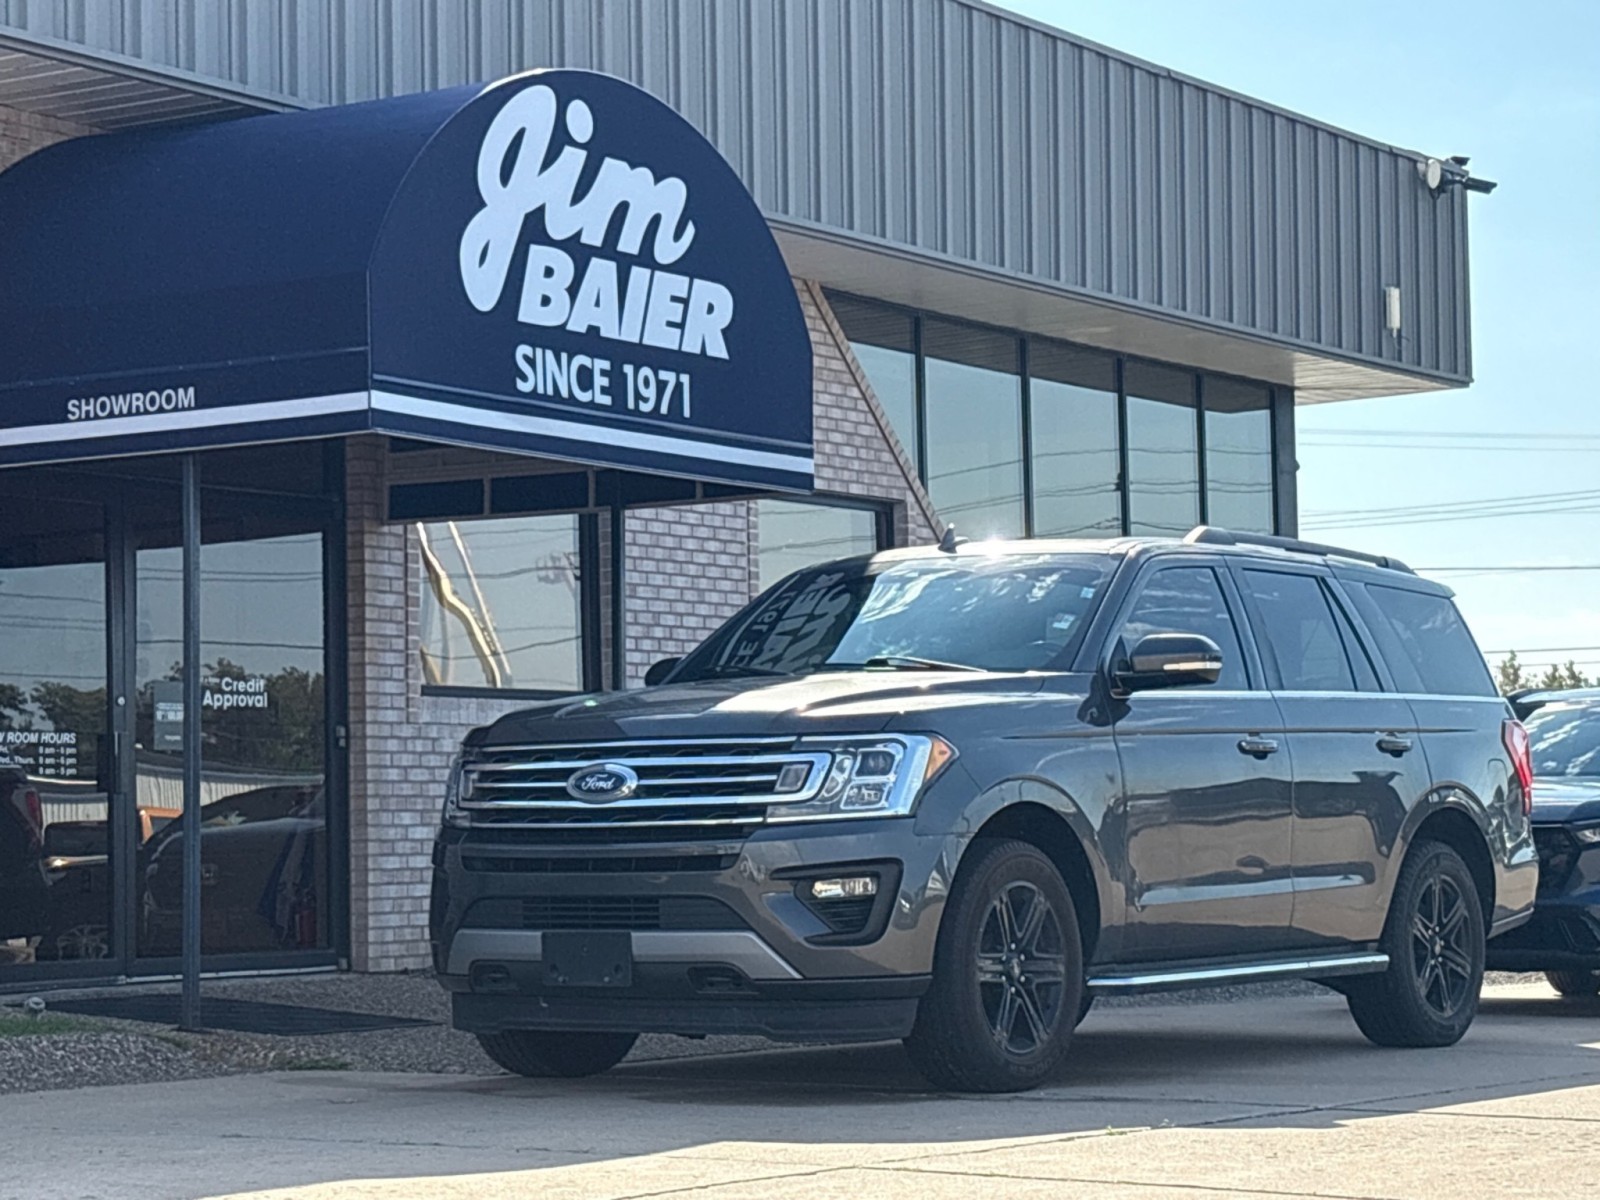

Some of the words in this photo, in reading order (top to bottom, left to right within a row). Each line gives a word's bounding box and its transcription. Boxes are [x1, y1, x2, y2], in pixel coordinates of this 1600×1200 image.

[459, 84, 696, 313] Jim
[517, 244, 734, 361] BAIER
[514, 344, 612, 407] SINCE
[621, 363, 692, 419] 1971
[67, 386, 196, 421] SHOWROOM
[222, 677, 265, 692] Credit
[202, 690, 268, 710] Approval
[7, 732, 39, 744] ROOM
[41, 732, 76, 744] HOURS
[581, 773, 616, 790] Ford
